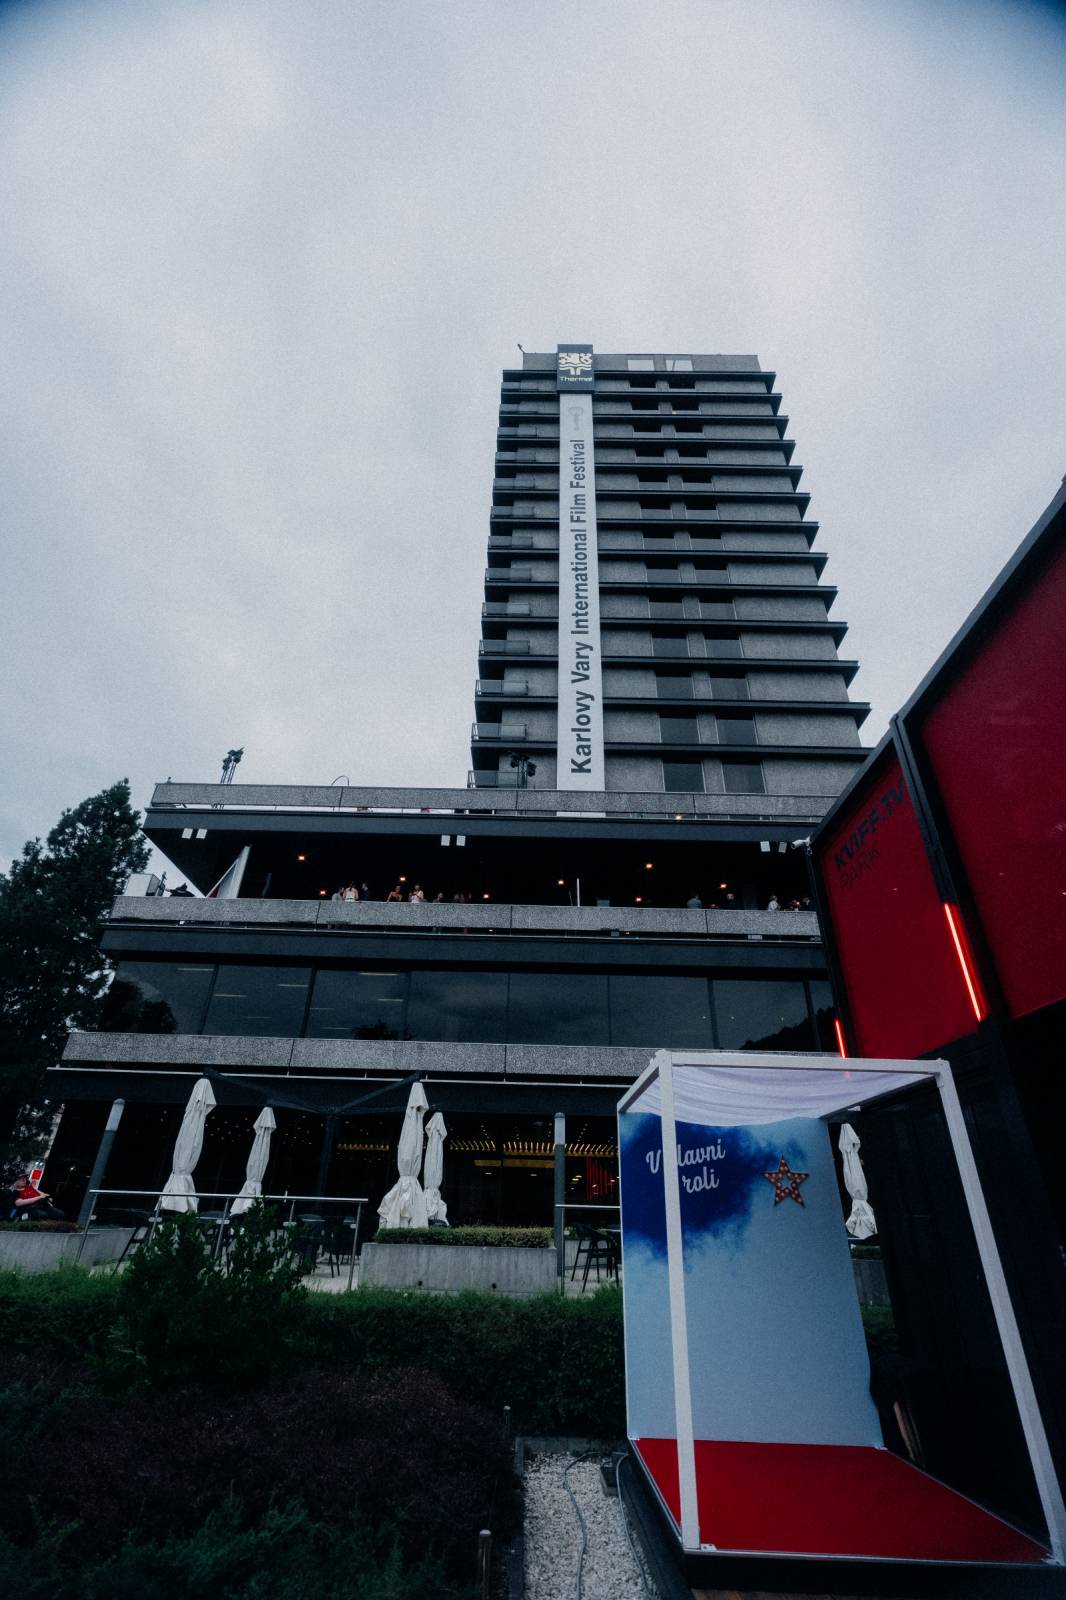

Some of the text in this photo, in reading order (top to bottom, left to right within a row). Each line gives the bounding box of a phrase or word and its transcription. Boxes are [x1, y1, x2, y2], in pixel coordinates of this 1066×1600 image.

[569, 439, 595, 774] Karlovy Vary International Film Festival
[645, 1138, 726, 1174] V lavní
[681, 1166, 720, 1194] roli
